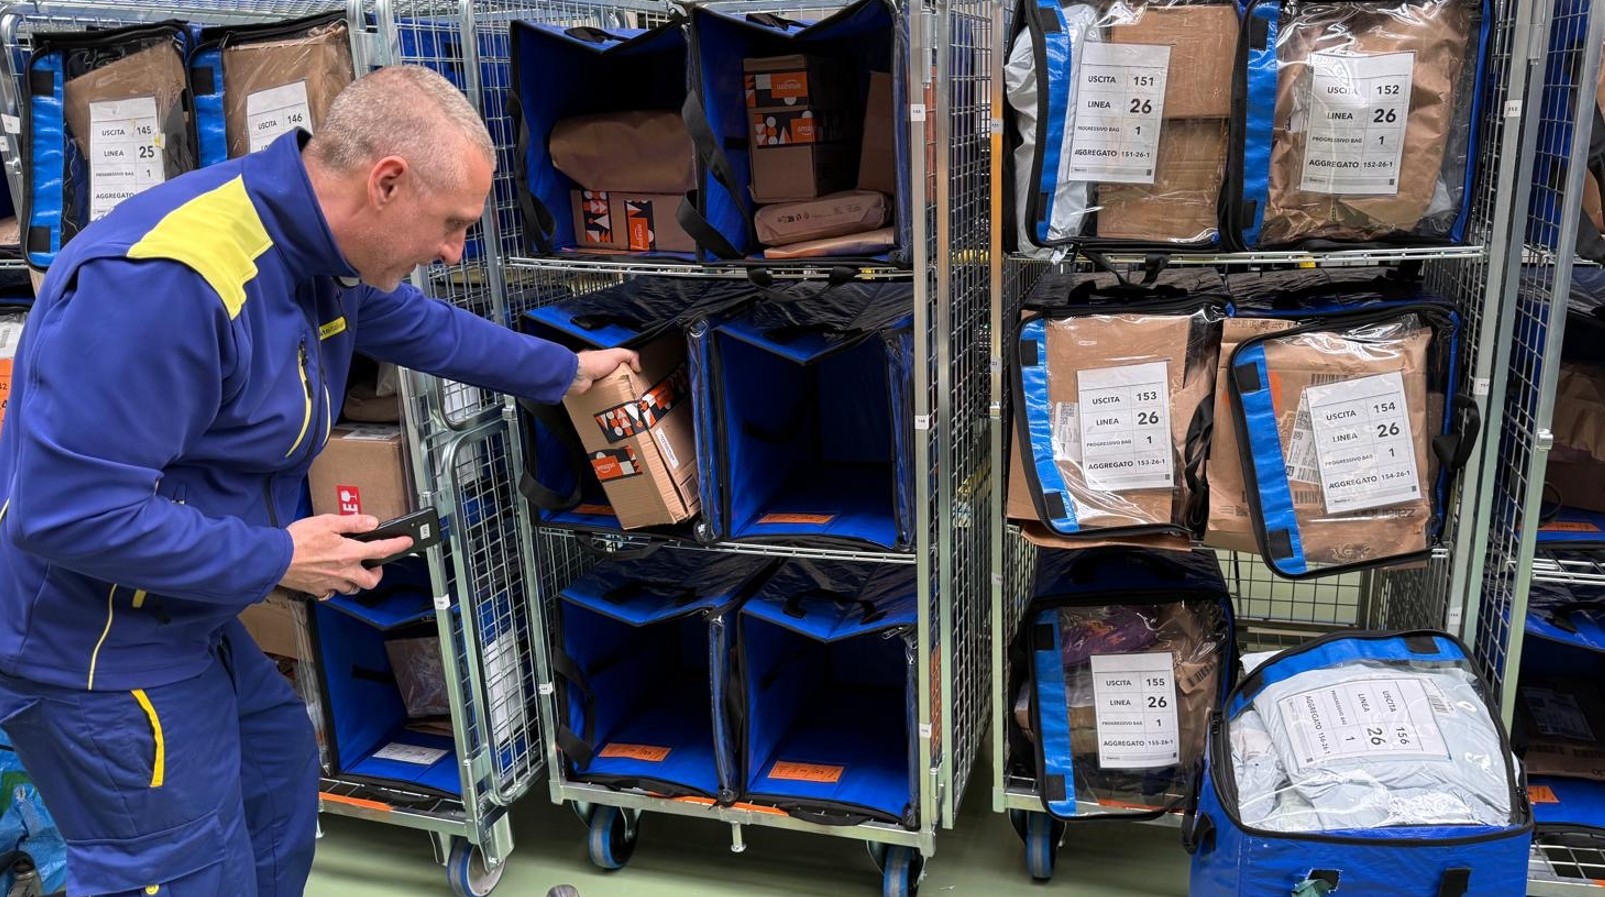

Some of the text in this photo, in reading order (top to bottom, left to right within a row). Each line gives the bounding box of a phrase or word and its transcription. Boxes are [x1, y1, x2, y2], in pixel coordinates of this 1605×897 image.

[1088, 76, 1154, 86] USCITA 151
[1376, 84, 1400, 94] 152
[1088, 98, 1152, 114] LINEA 26
[258, 113, 302, 130] USCITA 146
[1327, 108, 1396, 123] LINEA 26
[137, 126, 152, 135] 145
[1135, 126, 1141, 135] 1
[1312, 136, 1350, 144] PROGRESSIVO
[1379, 136, 1385, 145] 1
[139, 146, 154, 158] 25
[1074, 149, 1118, 157] AGGREGATO
[1308, 160, 1360, 168] AGGREGATO
[146, 170, 151, 178] 1
[1092, 392, 1157, 405] USCITA 153
[1326, 402, 1396, 421] USCITA 154
[1096, 411, 1159, 426] LINEA 26
[1332, 422, 1400, 443] LINEA 26
[1086, 440, 1121, 448] PROGRESSIVO
[1146, 436, 1152, 444] 1
[1324, 457, 1362, 467] PROGRESSIVO
[1388, 448, 1395, 457] 1
[1088, 461, 1134, 470] AGGREGATO
[1328, 470, 1410, 490] AGGREGATO 154-26-1
[1146, 678, 1165, 686] 155
[1148, 696, 1167, 708] 26
[1330, 690, 1344, 717] PROGRESSIVO
[1340, 716, 1348, 725] BAG
[1305, 695, 1322, 730] AGGREGATO
[1382, 690, 1410, 746] USCITA 156
[1156, 719, 1162, 727] 1
[1357, 693, 1386, 746] LINEA 26
